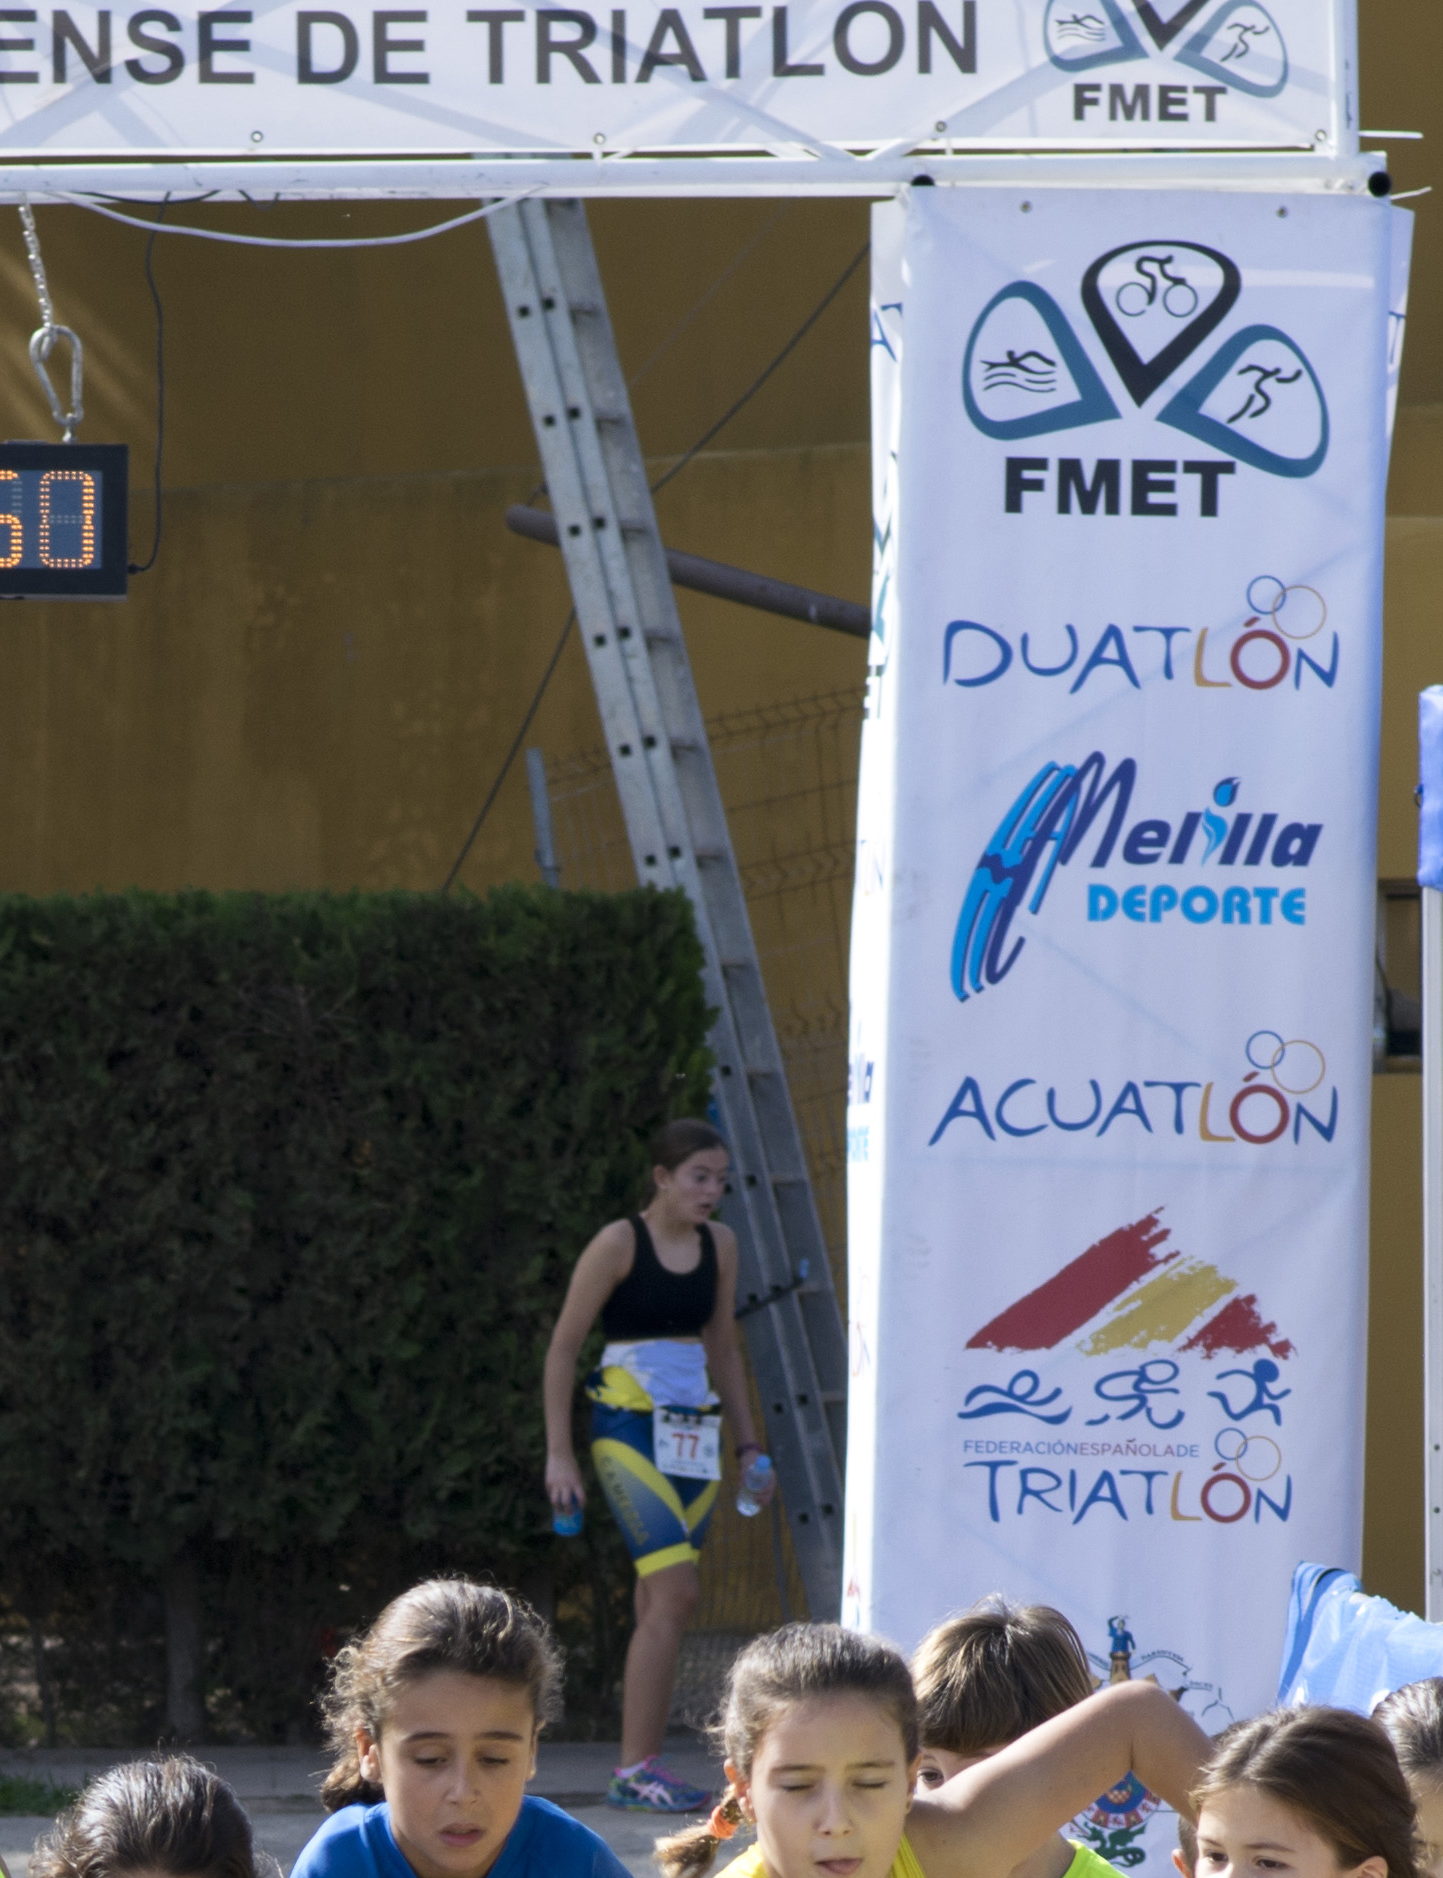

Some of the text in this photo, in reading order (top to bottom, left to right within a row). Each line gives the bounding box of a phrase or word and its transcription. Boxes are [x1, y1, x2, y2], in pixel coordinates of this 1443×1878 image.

[296, 10, 429, 84] DE
[1072, 83, 1228, 123] FMET
[1003, 456, 1237, 519] FMET
[943, 616, 1339, 695] DUATLÓN
[1086, 883, 1307, 926] DEPORTE
[927, 1071, 1339, 1146] ACUATLÓN
[672, 1431, 700, 1459] 77
[962, 1461, 1293, 1526] TRIATLÓN
